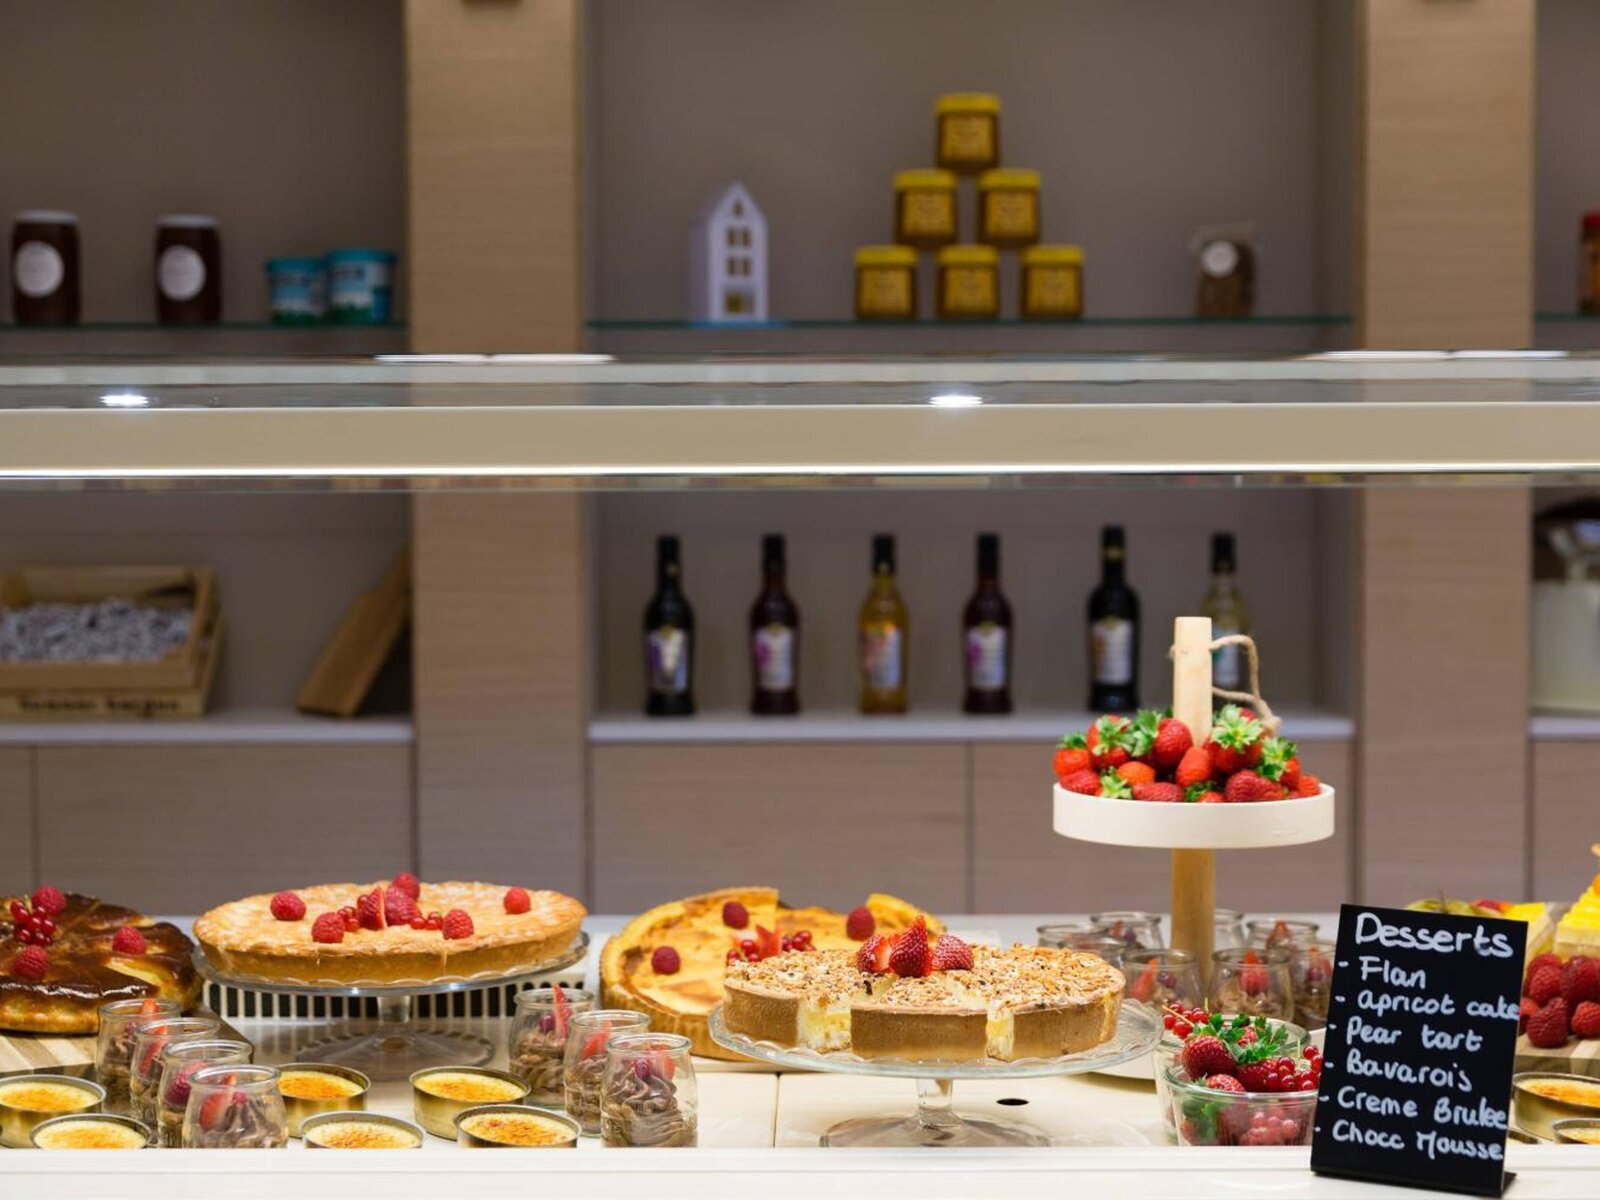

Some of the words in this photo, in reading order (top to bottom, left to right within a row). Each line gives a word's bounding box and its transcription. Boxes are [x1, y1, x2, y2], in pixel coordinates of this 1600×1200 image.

[1355, 911, 1514, 958] Desserts
[1358, 955, 1426, 990] Flan
[1466, 995, 1519, 1021] cake
[1346, 1015, 1402, 1045] Pear
[1421, 1024, 1483, 1052] tart
[1346, 1047, 1472, 1092] Bavarois
[1337, 1085, 1418, 1118] Creme
[1416, 1130, 1503, 1160] Mousse
